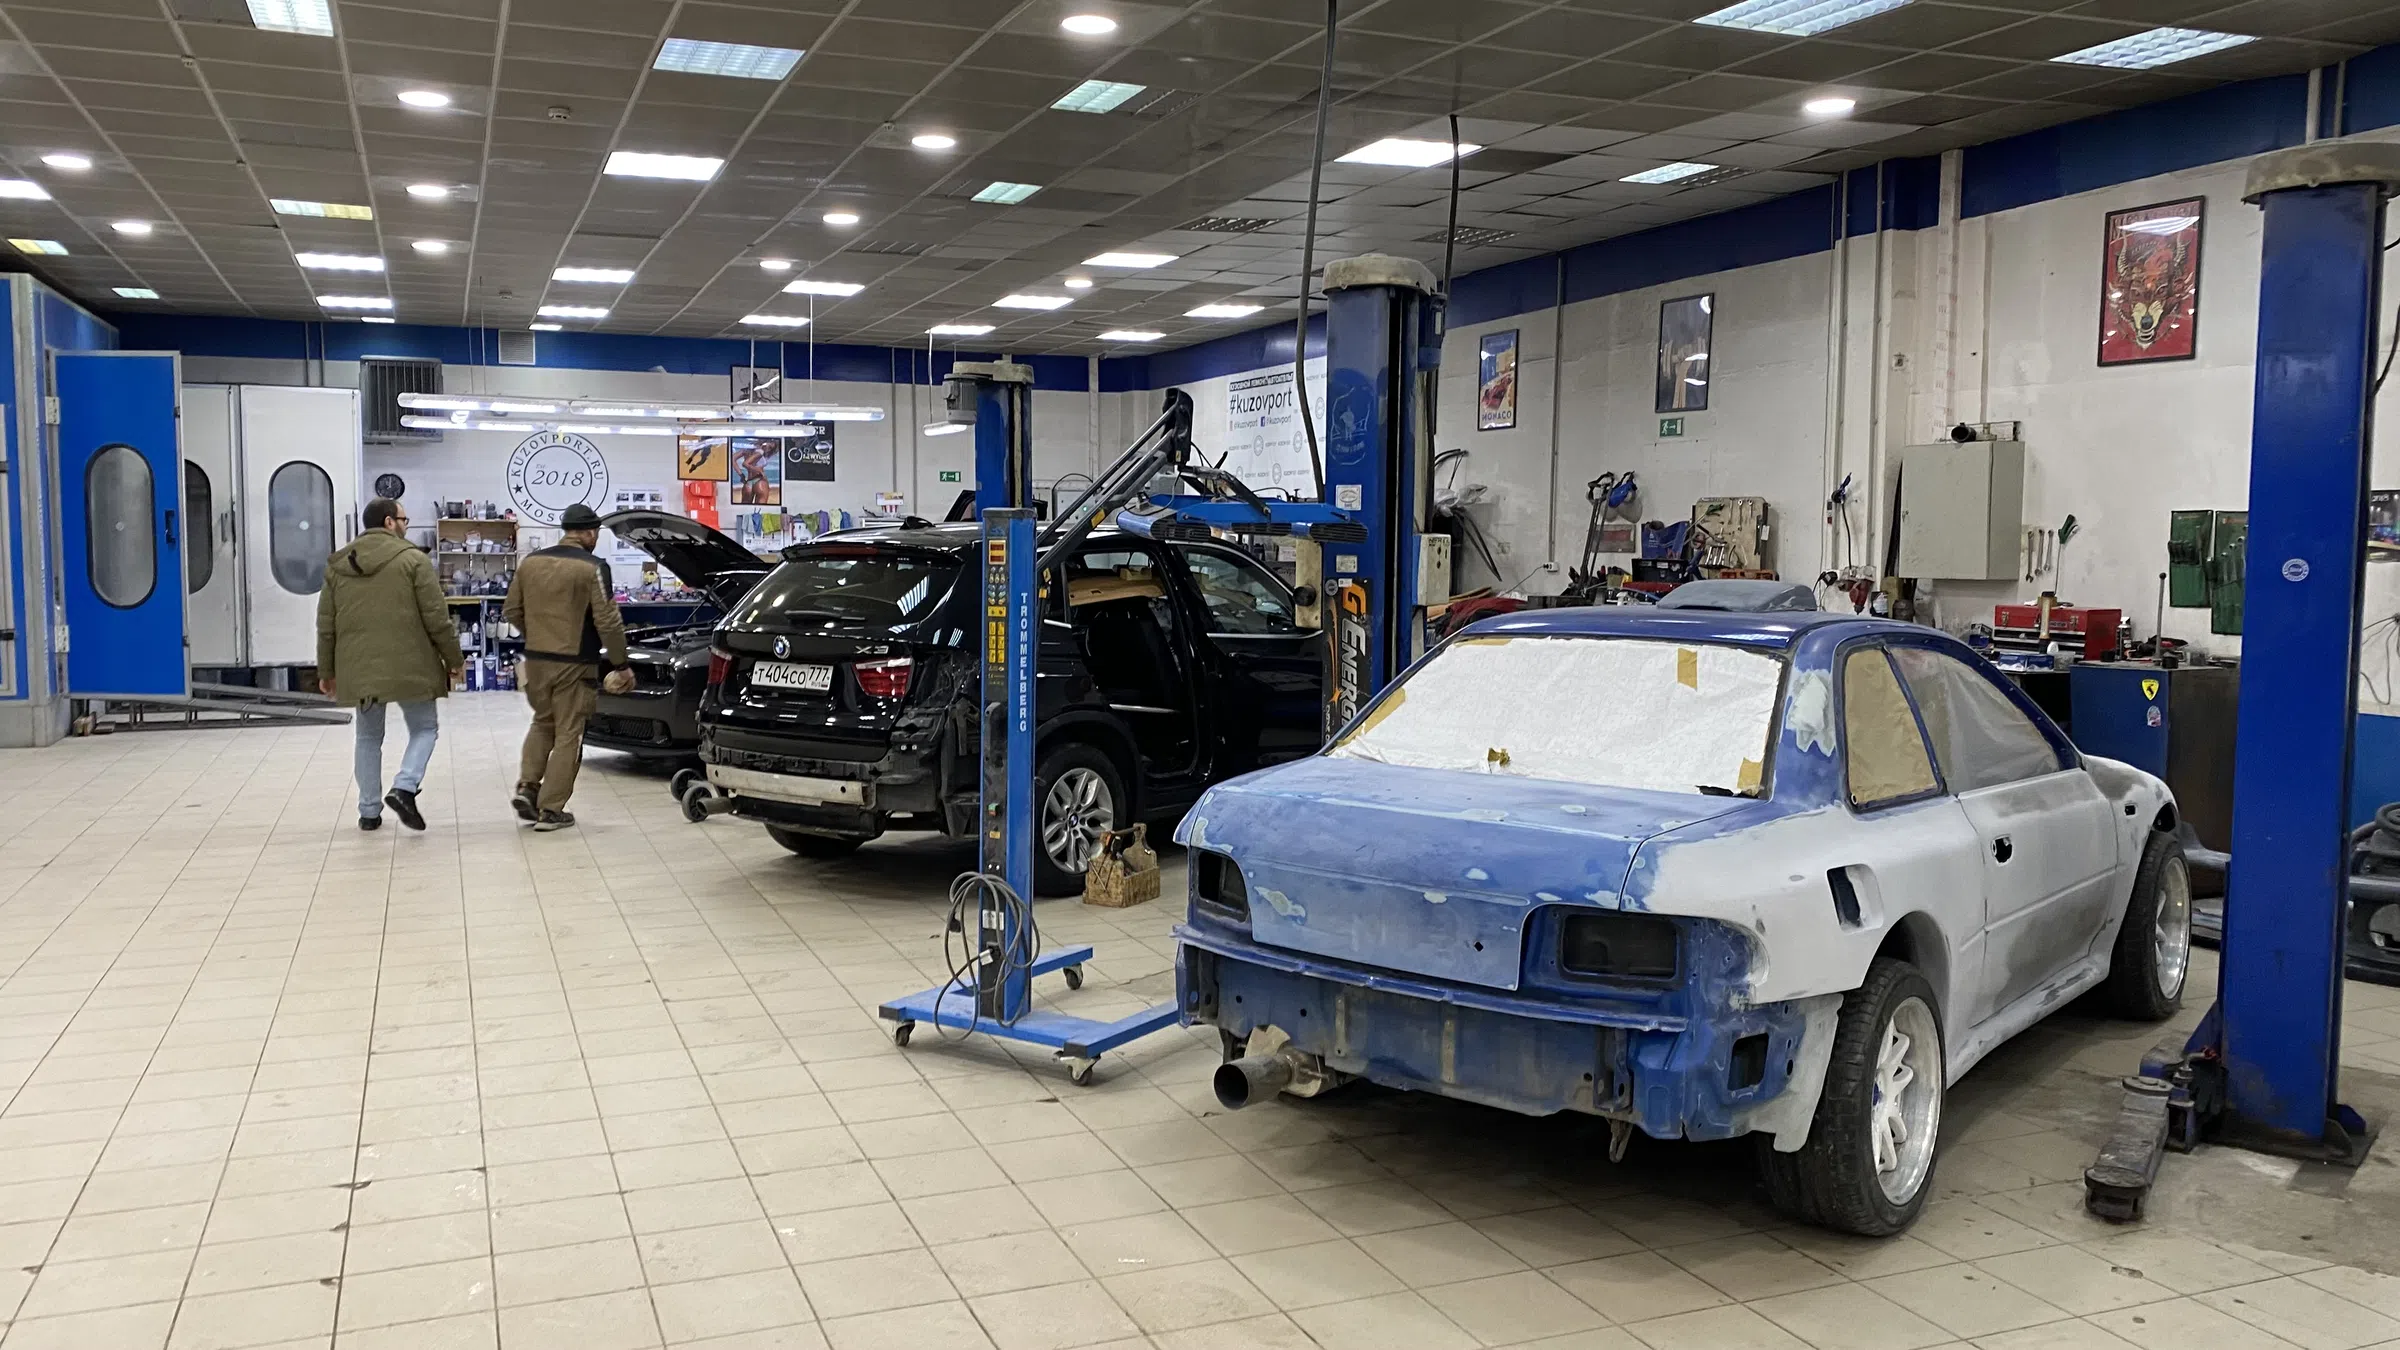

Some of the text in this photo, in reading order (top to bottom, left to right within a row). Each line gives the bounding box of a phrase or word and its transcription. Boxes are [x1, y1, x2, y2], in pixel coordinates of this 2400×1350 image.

[1230, 387, 1292, 415] #kuzovport
[1482, 410, 1512, 421] MONACO
[511, 433, 604, 480] KUZOVPORT.RU
[531, 469, 585, 487] 2018
[853, 645, 889, 655] X3
[1019, 592, 1028, 732] TROMMELBERG
[809, 666, 829, 682] 777
